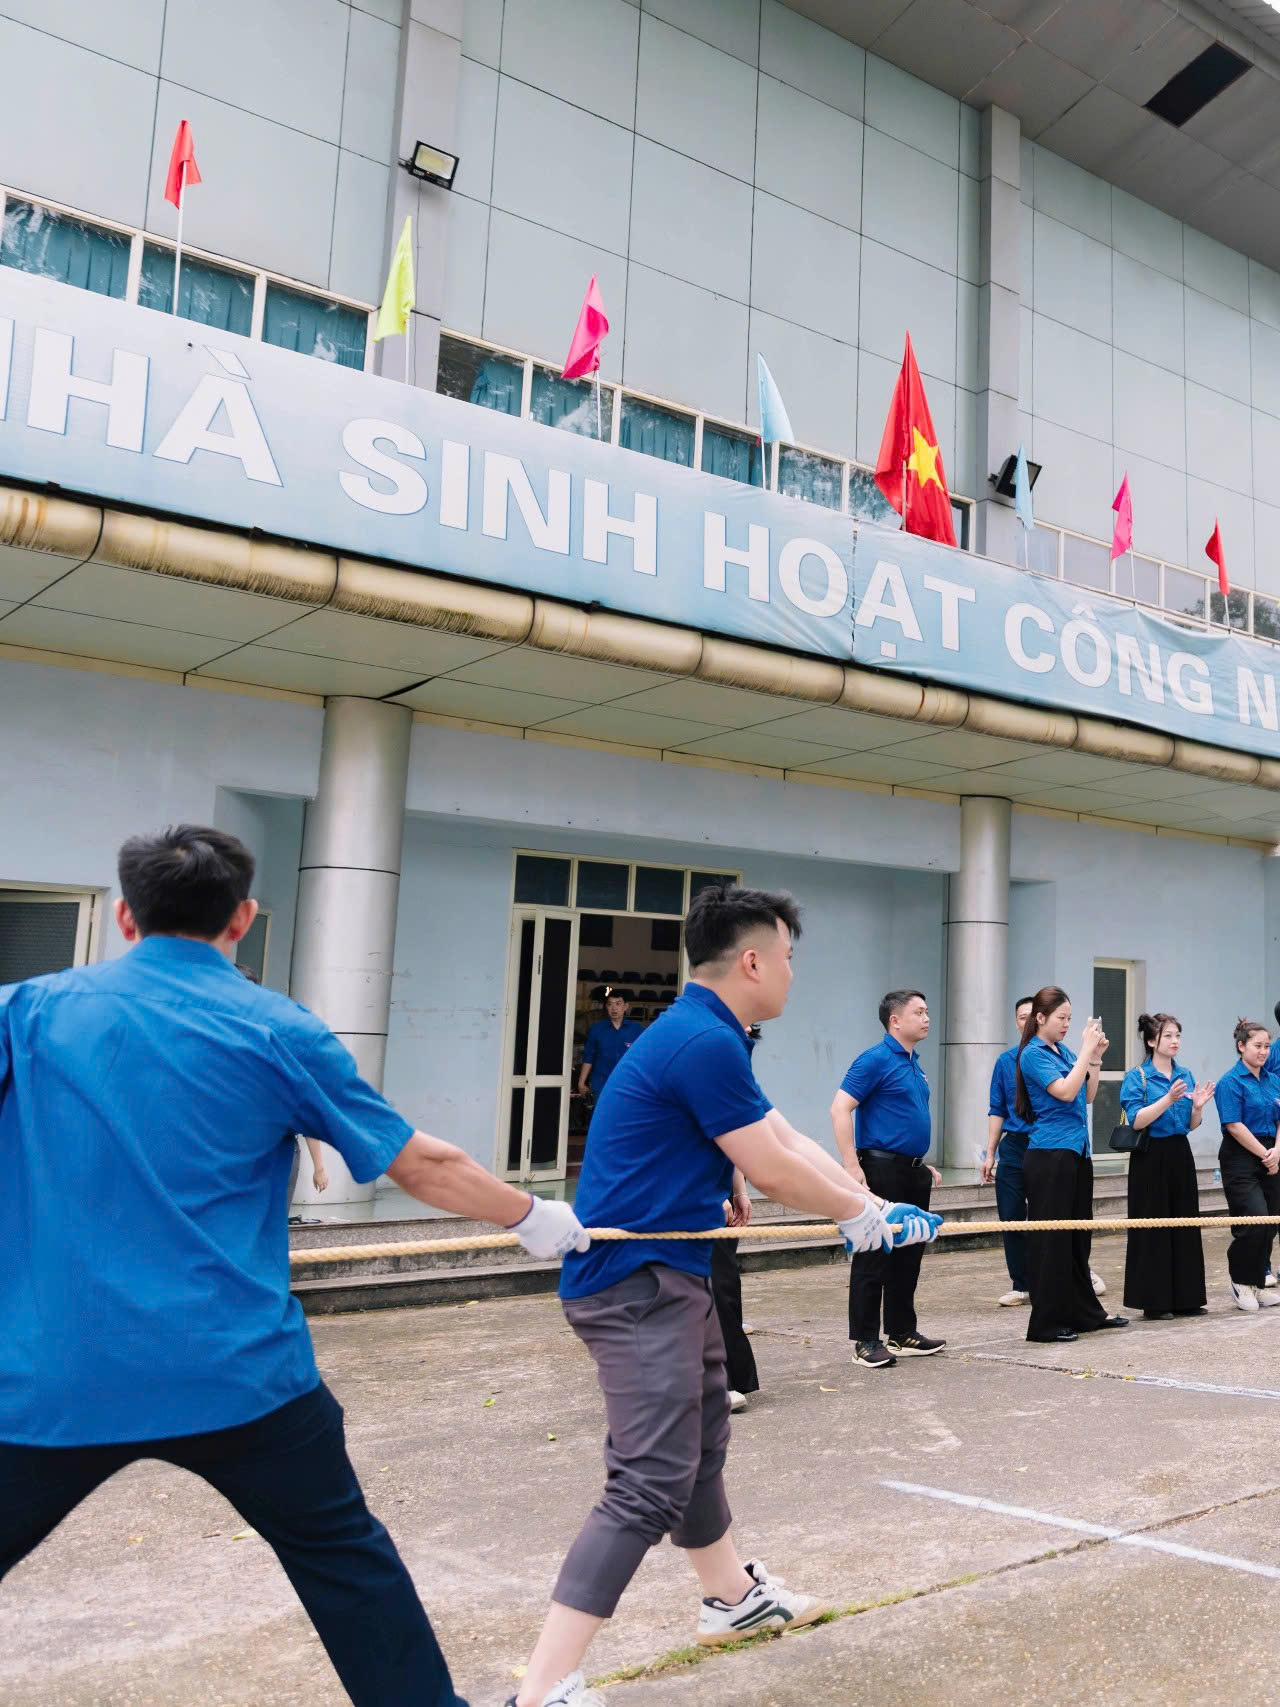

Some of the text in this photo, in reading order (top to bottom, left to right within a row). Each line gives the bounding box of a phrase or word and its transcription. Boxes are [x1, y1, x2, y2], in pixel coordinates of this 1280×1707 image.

[0, 316, 284, 487] HÀ
[338, 417, 658, 576] SINH
[702, 511, 976, 659] HOẠT
[1004, 602, 1215, 715] CÔNG
